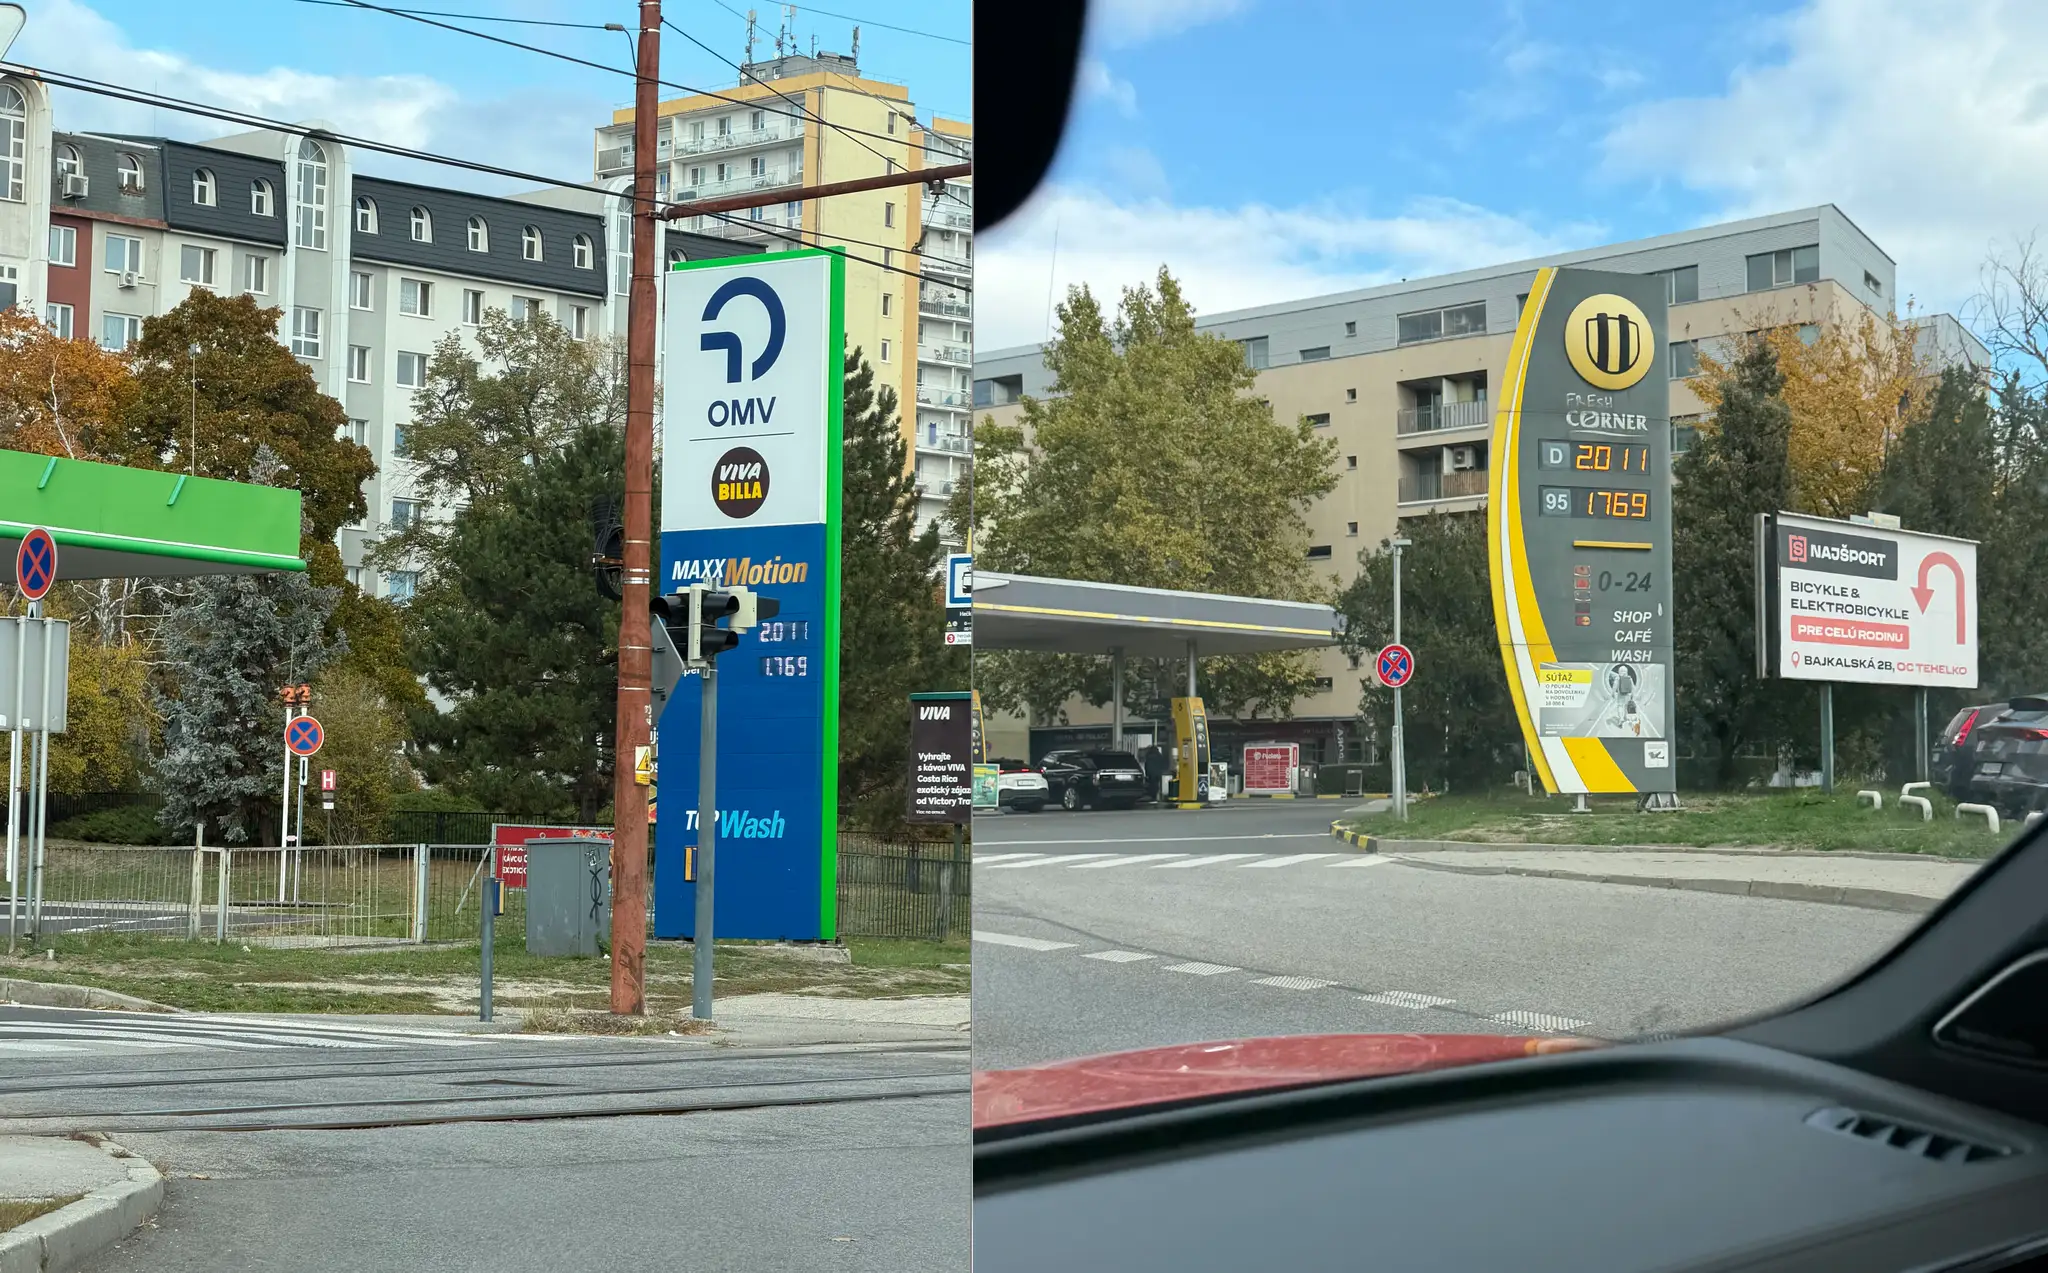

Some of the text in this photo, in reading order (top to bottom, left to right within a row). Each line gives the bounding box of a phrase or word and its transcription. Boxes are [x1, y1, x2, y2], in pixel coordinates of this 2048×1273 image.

[708, 396, 776, 427] OMV
[1550, 448, 1563, 464] D
[720, 462, 762, 481] VIVA
[718, 481, 763, 500] BILLA
[1545, 493, 1568, 511] 95
[1810, 544, 1886, 567] NAJŠPORT
[1790, 581, 1860, 598] BICYKLE &
[1612, 610, 1652, 623] SHOP
[1790, 599, 1909, 619] ELEKTROBICYKLE
[1614, 628, 1652, 643] CAFÉ
[1798, 624, 1904, 643] PRE CELÚ RODINU
[1611, 650, 1652, 662] WASH
[1804, 655, 1968, 675] BAJKALSKÁ 2B, OC TEHELKO
[1545, 671, 1573, 682] SÚŤAŽ
[920, 706, 951, 720] VIVA
[918, 752, 951, 762] Vyhrajte
[923, 763, 947, 771] kávou
[323, 771, 334, 789] H
[916, 786, 950, 796] exotický
[916, 797, 927, 805] od
[928, 797, 957, 807] Victory
